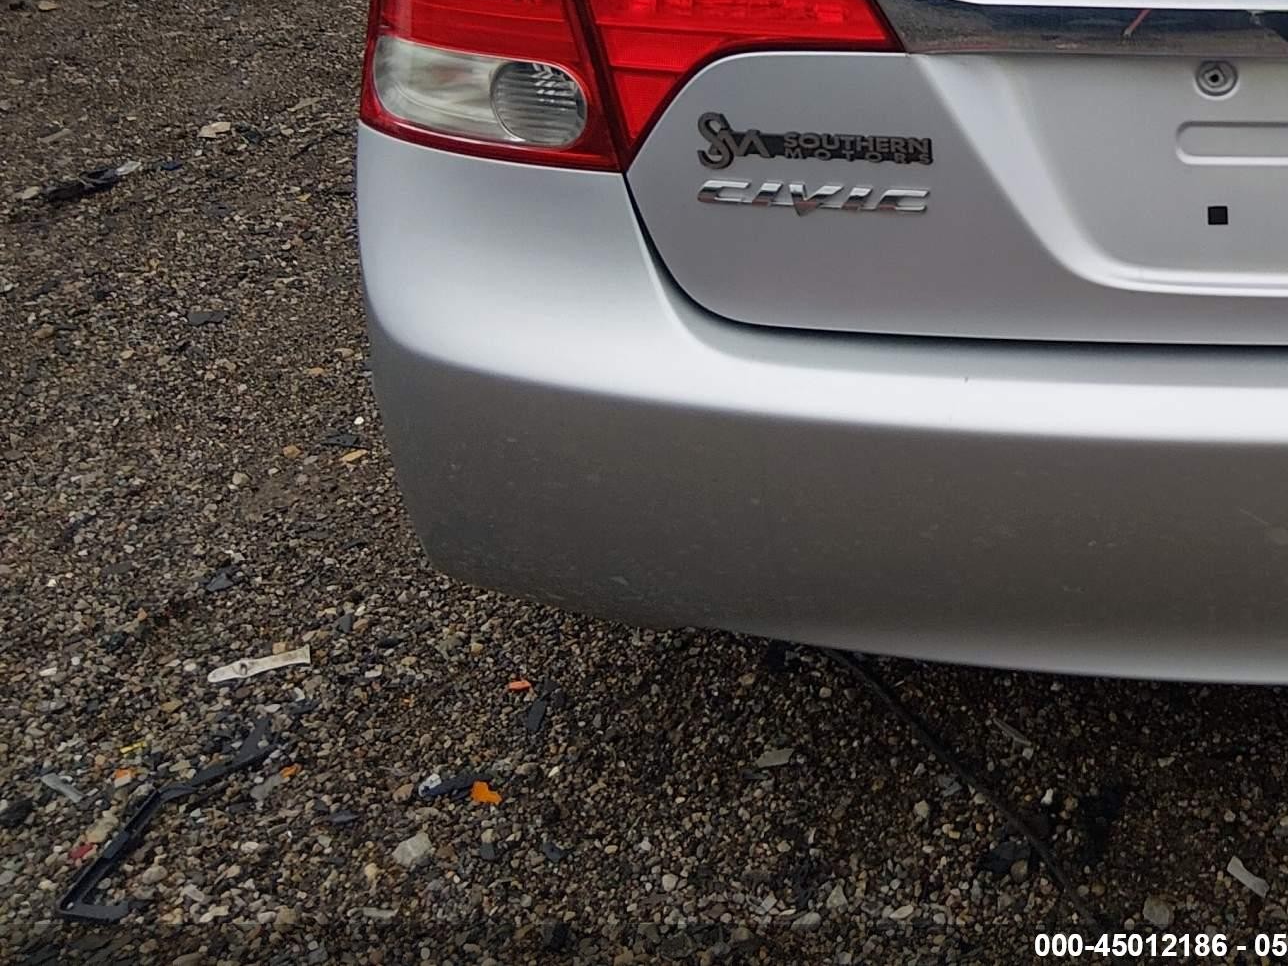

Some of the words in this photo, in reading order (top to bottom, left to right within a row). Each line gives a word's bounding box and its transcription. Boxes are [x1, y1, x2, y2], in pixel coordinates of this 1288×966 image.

[783, 131, 932, 155] SOUTHERN
[784, 147, 933, 165] MOTORS
[697, 178, 932, 216] CIVIC
